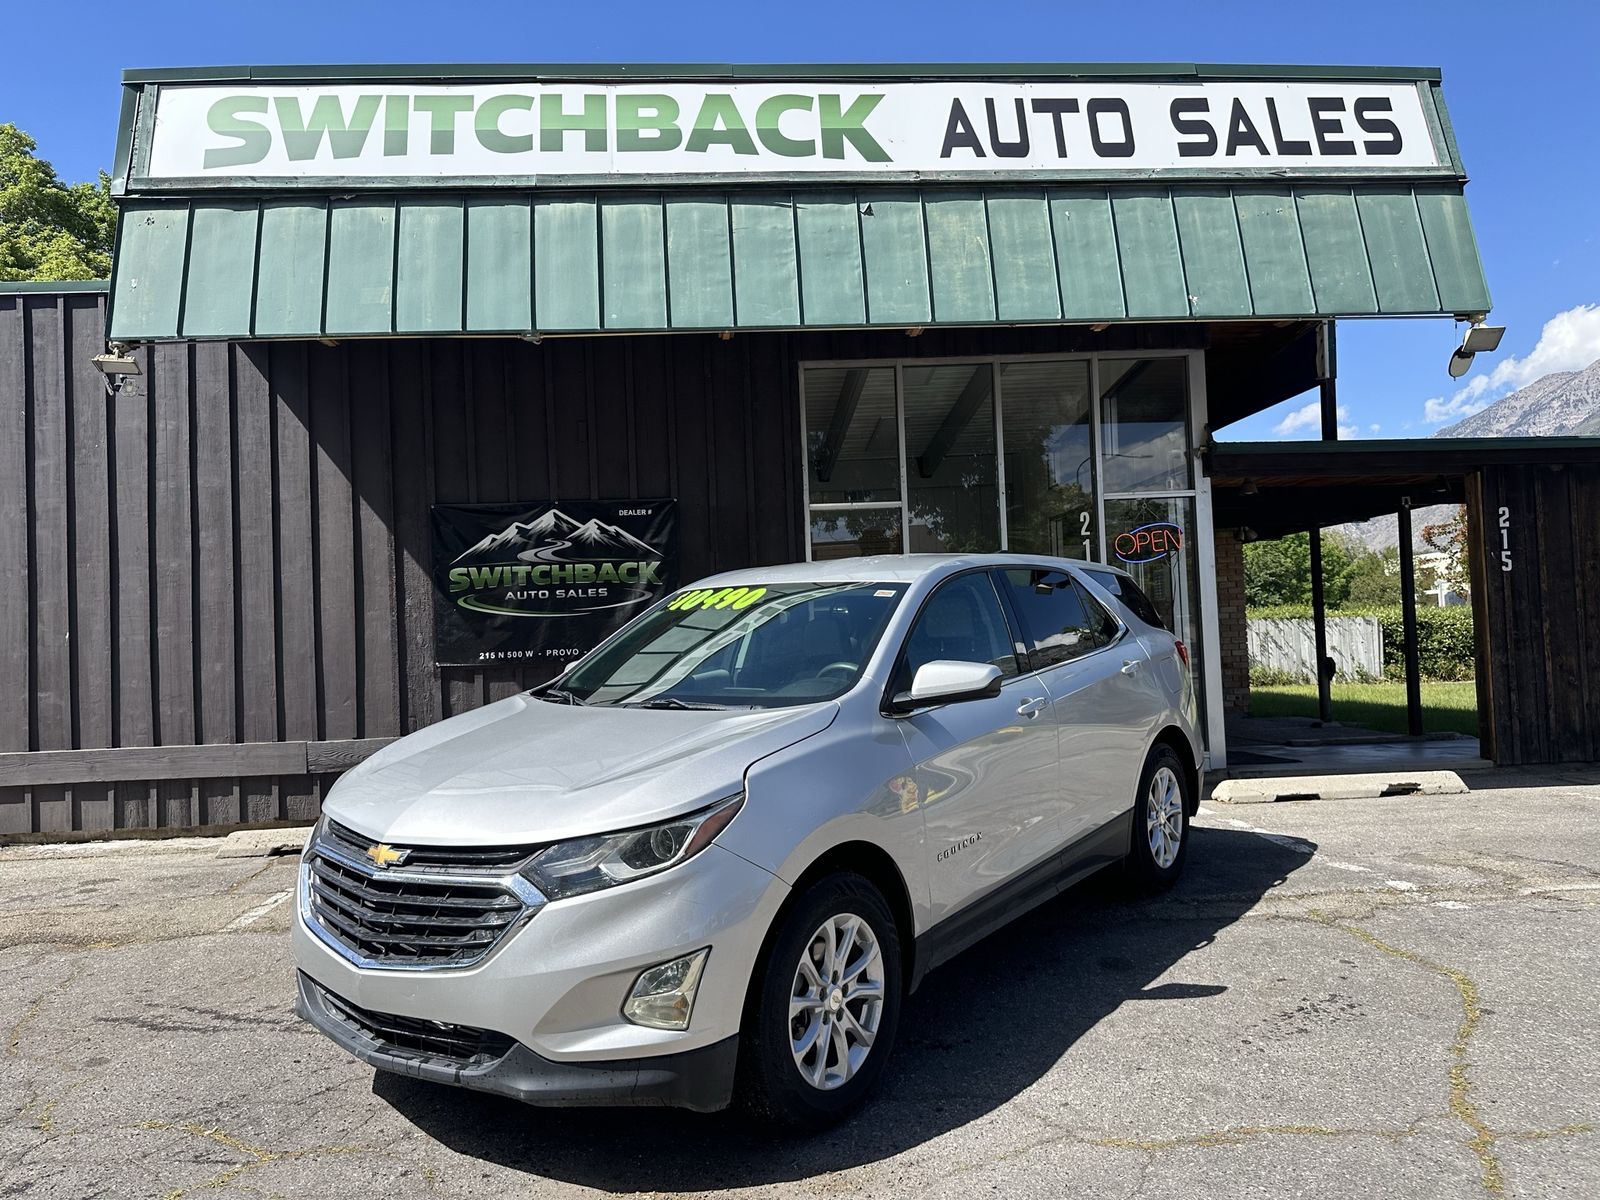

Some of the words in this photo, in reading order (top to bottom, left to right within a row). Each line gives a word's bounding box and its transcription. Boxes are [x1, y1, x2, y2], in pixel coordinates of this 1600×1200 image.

[203, 93, 893, 169] SWITCHBACK
[940, 97, 1135, 158] AUTO
[1169, 96, 1402, 156] SALES
[1114, 528, 1183, 555] OPEN
[1498, 506, 1513, 572] 215
[448, 560, 664, 593] SWITCHBACK
[504, 589, 549, 601] AUTO
[556, 587, 609, 600] SALES
[479, 652, 496, 660] 215
[498, 651, 505, 659] N
[507, 650, 523, 659] 500
[525, 650, 534, 658] W
[546, 648, 579, 657] PROVO
[936, 831, 983, 863] EQUINOX
